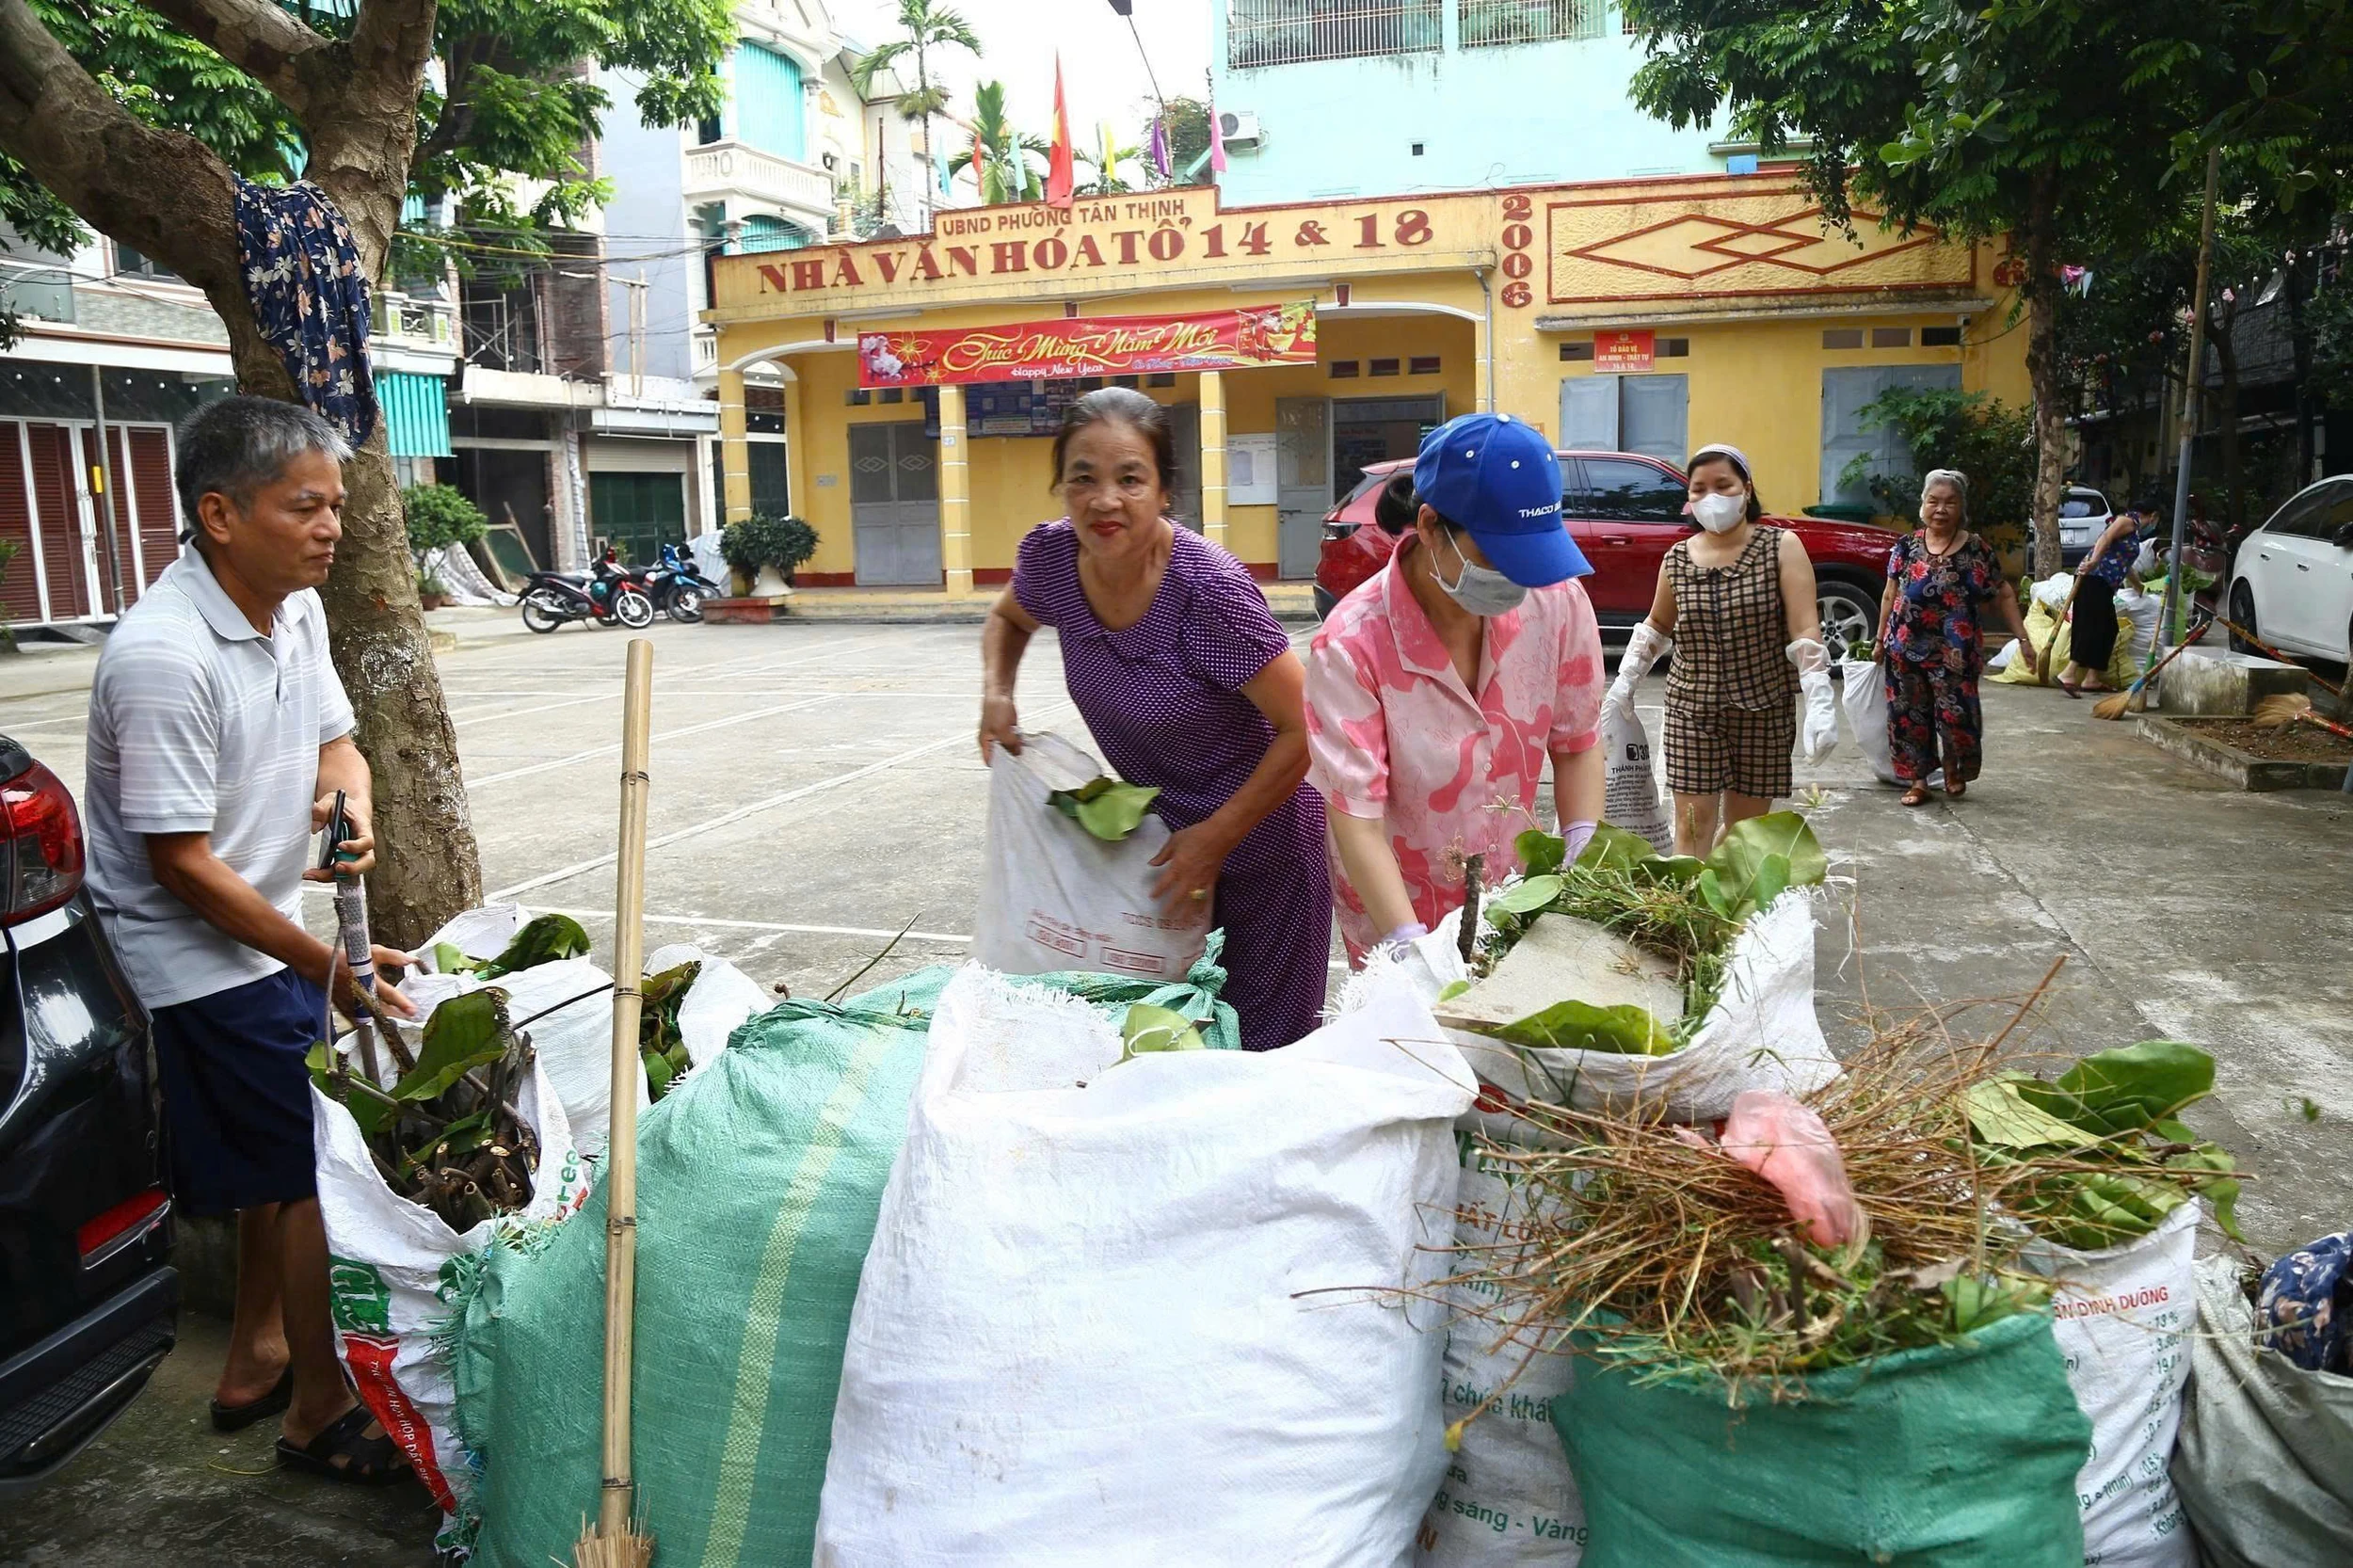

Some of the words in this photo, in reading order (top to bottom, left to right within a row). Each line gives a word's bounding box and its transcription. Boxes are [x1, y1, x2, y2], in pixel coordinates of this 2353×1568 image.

[942, 218, 991, 236] UBND
[998, 205, 1072, 232] PHƯỜNG
[1079, 200, 1118, 224] TÂN
[1125, 198, 1185, 221] THỊNH
[757, 248, 864, 294] NHÀ
[872, 241, 980, 283] VĂN
[990, 227, 1105, 274] HÓA
[1112, 216, 1193, 265] TỔ
[1200, 220, 1273, 258] 14
[1294, 219, 1332, 248] &
[1353, 209, 1434, 248] 18
[942, 331, 1016, 371] Chúc
[1016, 333, 1088, 365] Mừng
[1075, 328, 1155, 356] Năm
[1152, 321, 1220, 353] Mới
[1010, 365, 1048, 378] Happy
[1048, 363, 1074, 376] New
[1077, 361, 1105, 374] Year
[1517, 504, 1554, 519] THACO
[1452, 1501, 1509, 1533] sáng
[1532, 1515, 1590, 1546] Vàng
